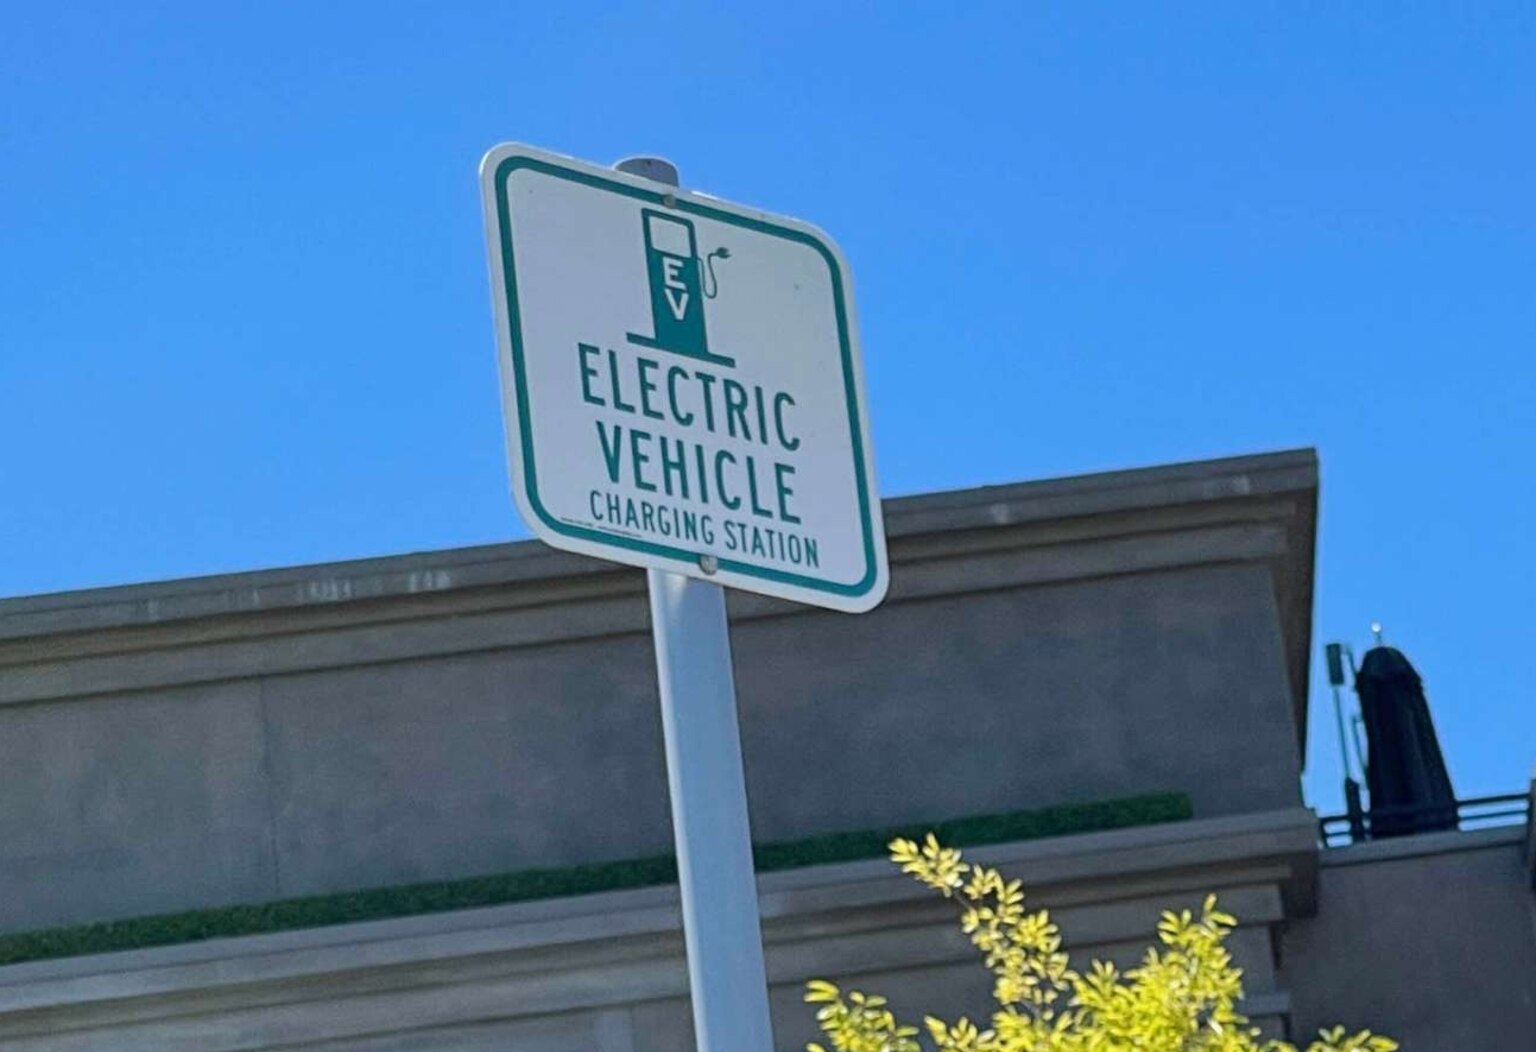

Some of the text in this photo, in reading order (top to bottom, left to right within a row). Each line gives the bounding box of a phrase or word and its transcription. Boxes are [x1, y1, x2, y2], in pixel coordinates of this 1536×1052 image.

[661, 256, 688, 320] EV
[578, 342, 800, 451] ELECTRIC
[596, 420, 801, 524] VEHICLE
[590, 490, 714, 545] CHARGING
[725, 519, 819, 569] STATION
